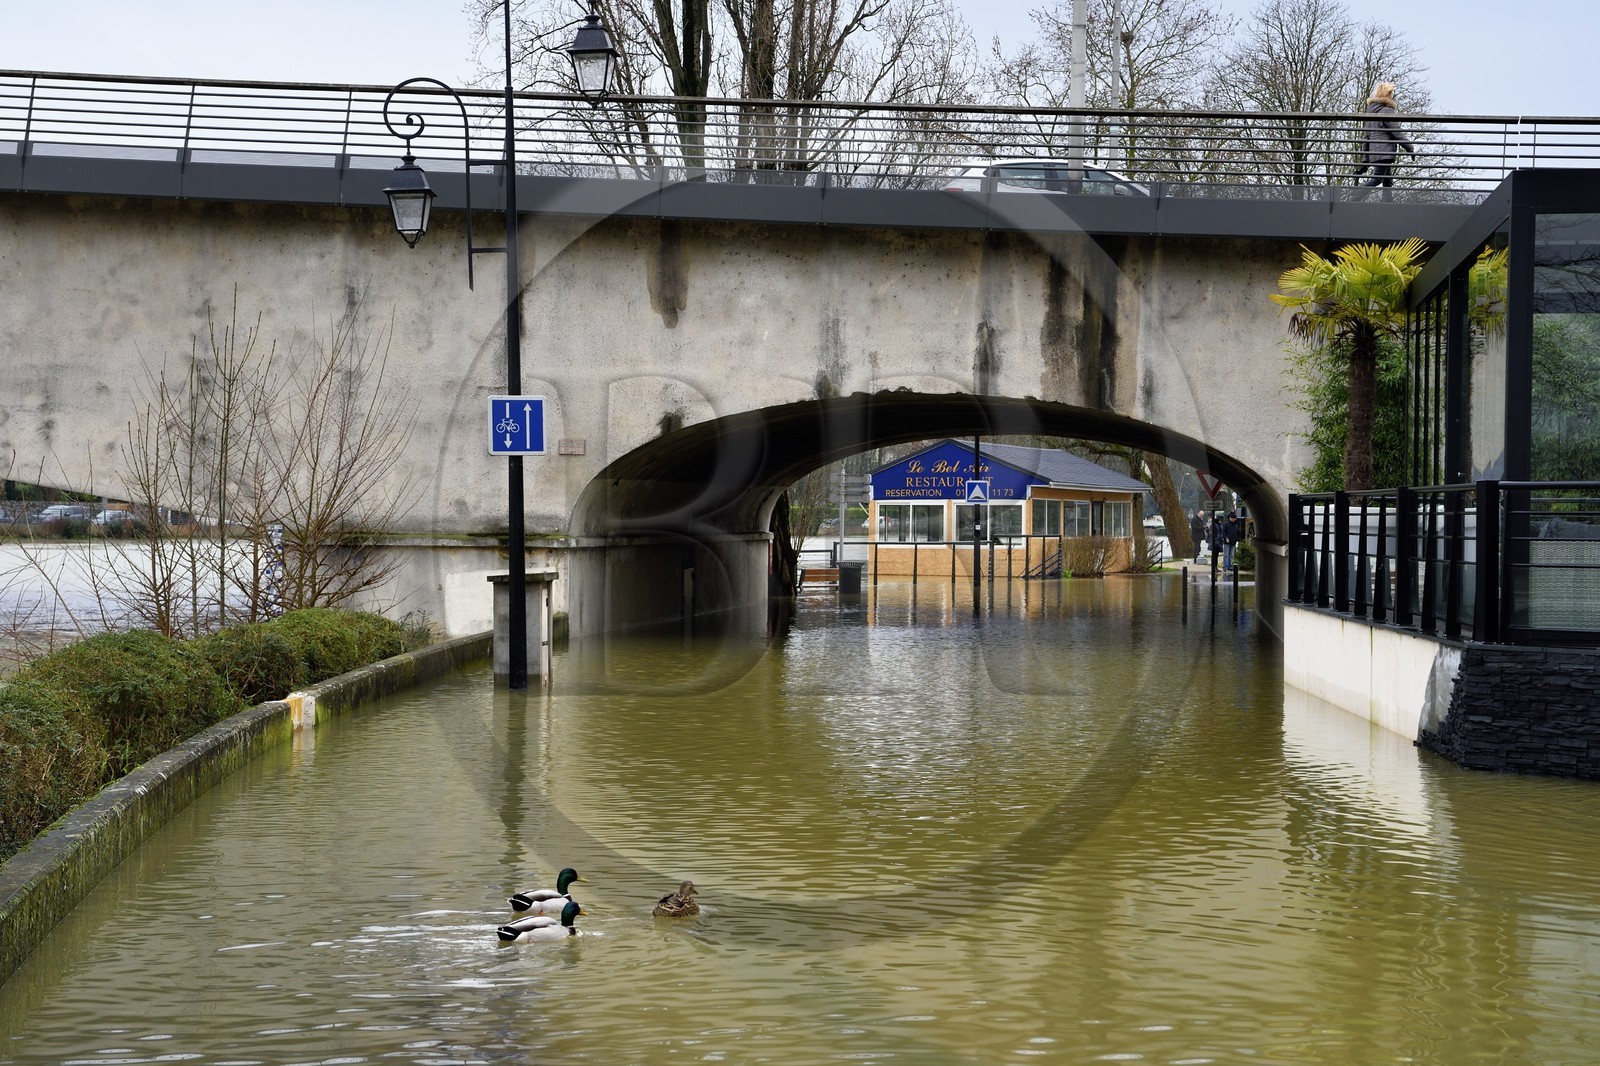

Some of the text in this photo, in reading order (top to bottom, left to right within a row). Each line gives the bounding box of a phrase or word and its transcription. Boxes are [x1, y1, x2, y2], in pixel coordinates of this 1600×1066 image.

[906, 460, 926, 473] Le
[931, 460, 960, 473] Bel
[906, 476, 993, 487] RESTAURT
[885, 488, 1014, 497] RESERVATION 01 11 73
